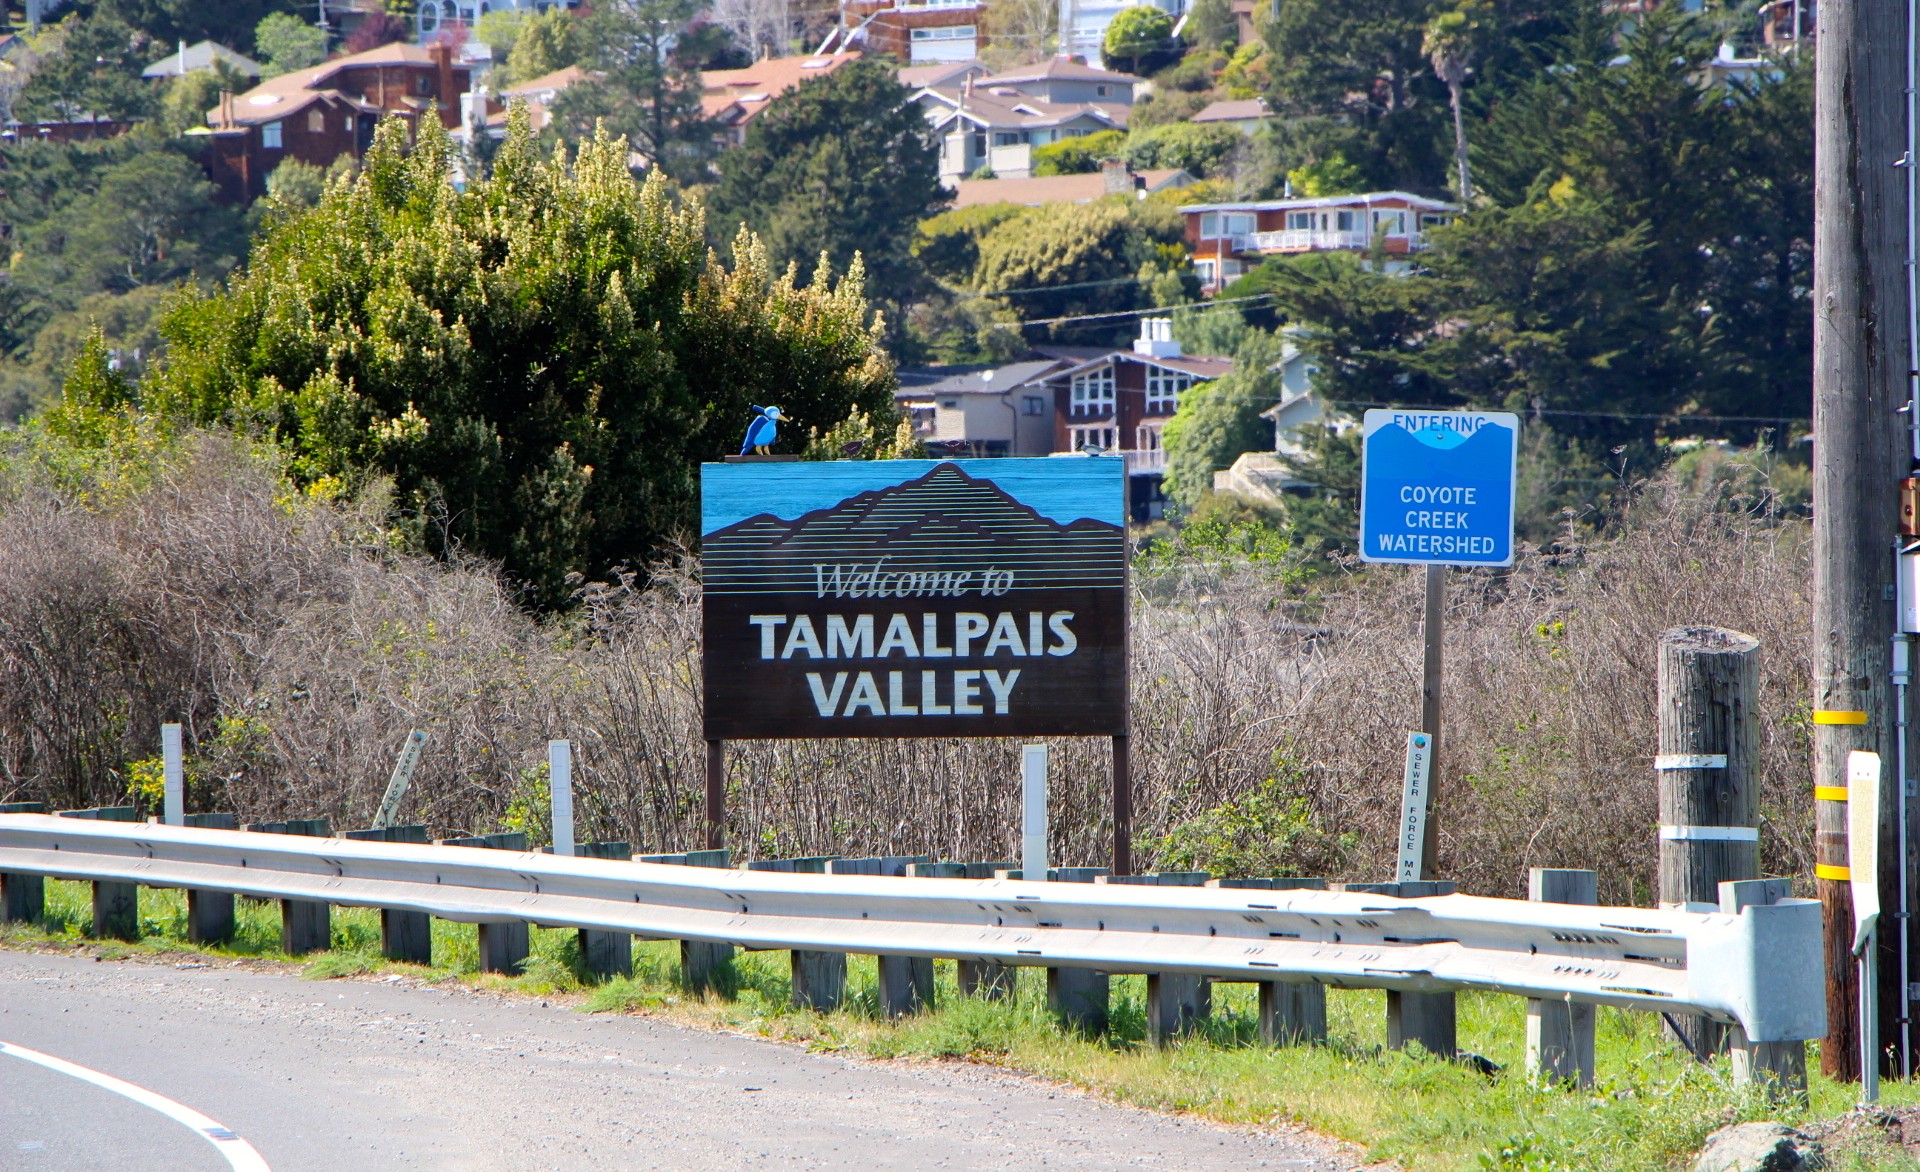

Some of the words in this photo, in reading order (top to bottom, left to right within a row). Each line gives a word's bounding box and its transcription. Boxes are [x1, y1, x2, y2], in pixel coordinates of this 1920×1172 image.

[1393, 414, 1486, 432] ENTERING
[1400, 486, 1477, 505] COYOTE
[1405, 510, 1469, 529] CREEK
[1379, 534, 1495, 554] WATERSHED
[813, 554, 973, 599] Welcome
[983, 565, 1015, 597] to
[749, 611, 1078, 660] TAMALPAIS
[806, 669, 1022, 717] VALLEY
[1411, 753, 1422, 797] SEWER
[1407, 806, 1417, 850] FORCE
